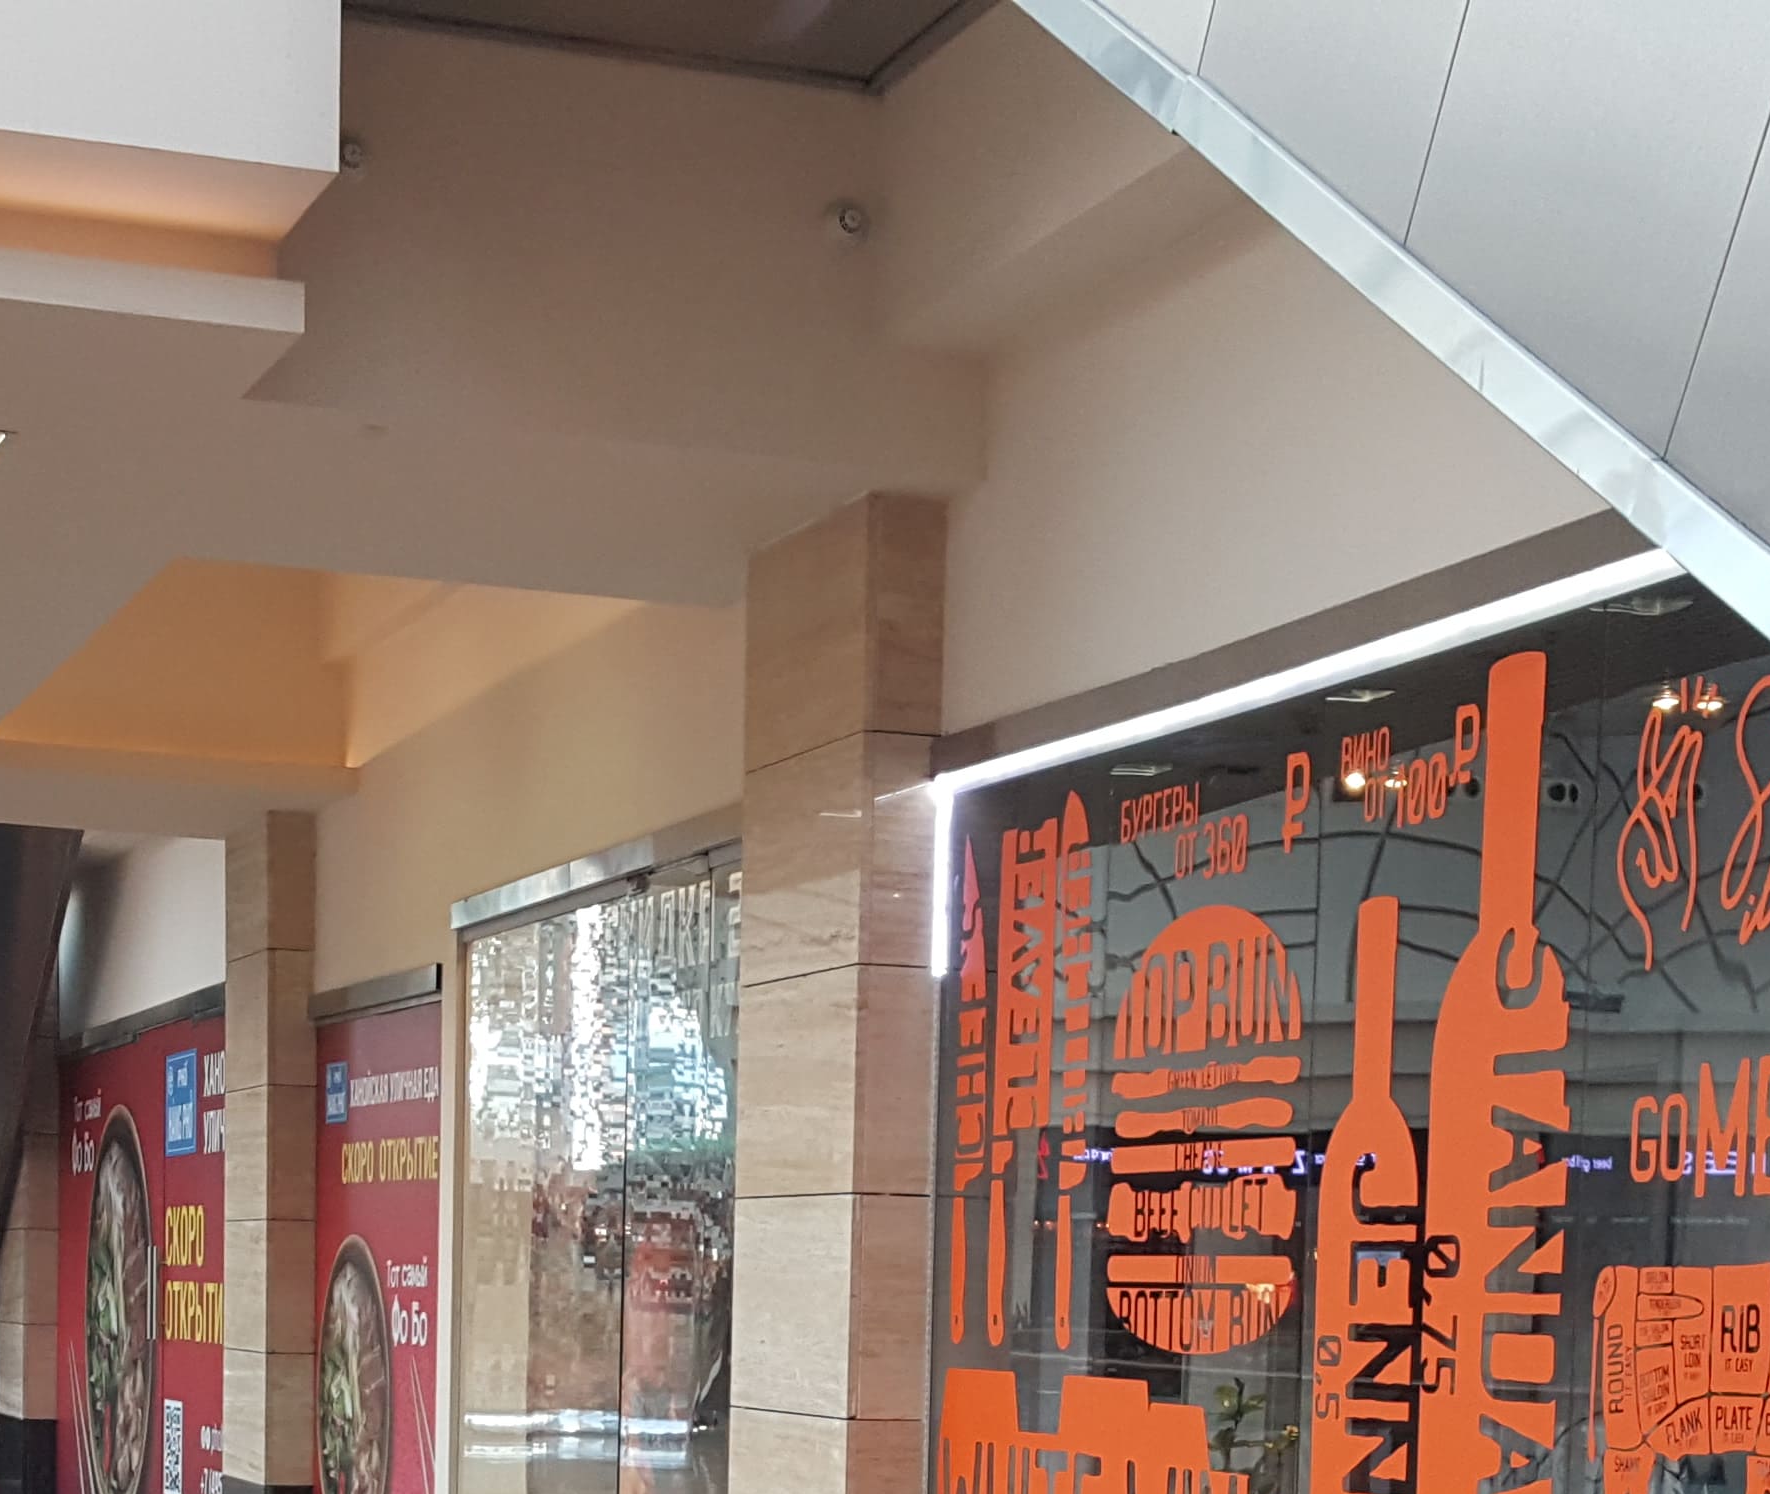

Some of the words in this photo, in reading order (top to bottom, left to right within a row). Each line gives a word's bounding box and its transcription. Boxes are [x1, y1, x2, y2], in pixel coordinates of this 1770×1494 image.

[1119, 781, 1201, 845] БУРГЕРЫ
[1395, 751, 1448, 829] 100
[1174, 830, 1198, 880] ОТ
[1202, 812, 1249, 880] 360
[341, 1140, 374, 1184] СКОРО
[379, 1135, 438, 1182] ОТКРЫТИЕ
[1630, 1092, 1688, 1182] GO
[165, 1204, 205, 1267] СКОРО
[391, 1293, 409, 1347] Фо
[411, 1300, 428, 1347] Бо
[1607, 1324, 1625, 1415] ROUND
[1715, 1405, 1753, 1431] PLATE
